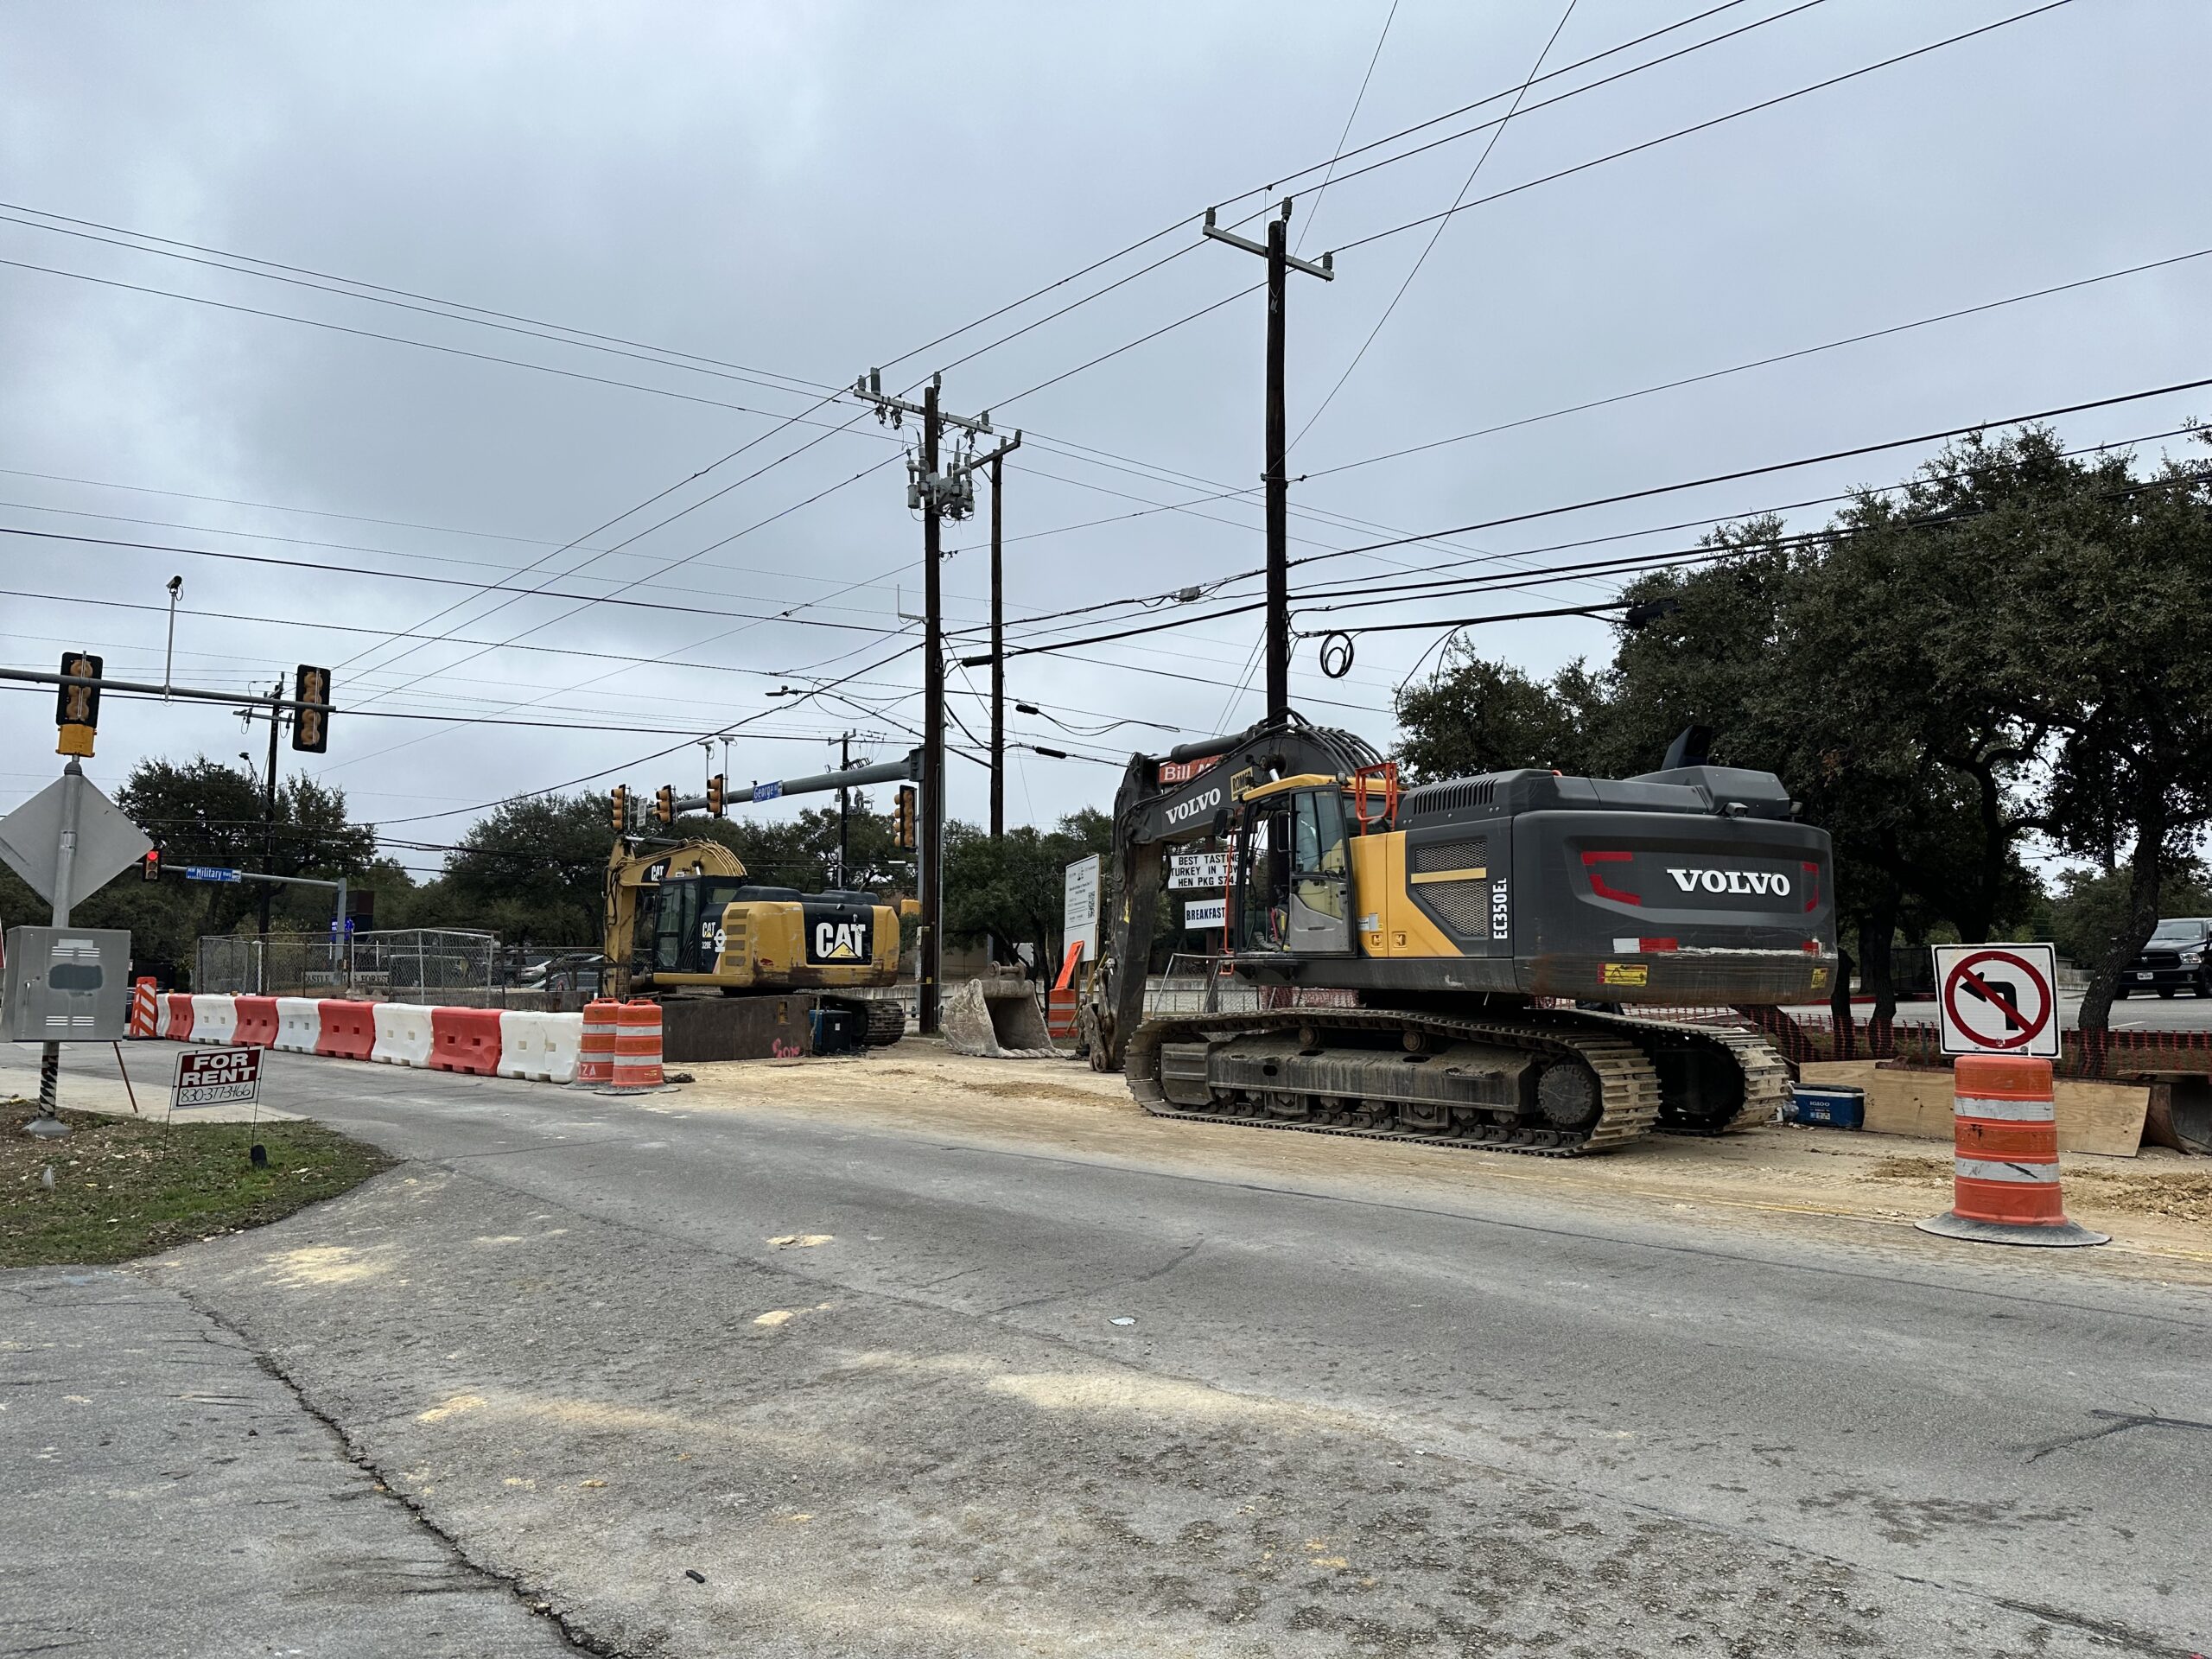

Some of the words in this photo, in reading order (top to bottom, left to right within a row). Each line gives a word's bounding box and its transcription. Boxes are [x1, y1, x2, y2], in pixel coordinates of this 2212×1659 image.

[1164, 766, 1191, 781] Bill
[753, 785, 773, 799] George
[1166, 788, 1221, 824] VOLVO
[1179, 856, 1199, 866] BEST
[196, 867, 222, 880] Military
[651, 865, 664, 881] CAT
[1171, 866, 1201, 877] TURKEY
[1208, 866, 1217, 874] IN
[1179, 877, 1193, 887] HEN
[1198, 876, 1214, 887] PKG
[1666, 868, 1790, 896] VOLVO
[1186, 906, 1225, 921] BREAKFAST
[702, 921, 715, 938] CAT
[816, 922, 866, 958] CAT
[193, 1052, 249, 1071] FOR
[181, 1065, 256, 1086] RENT
